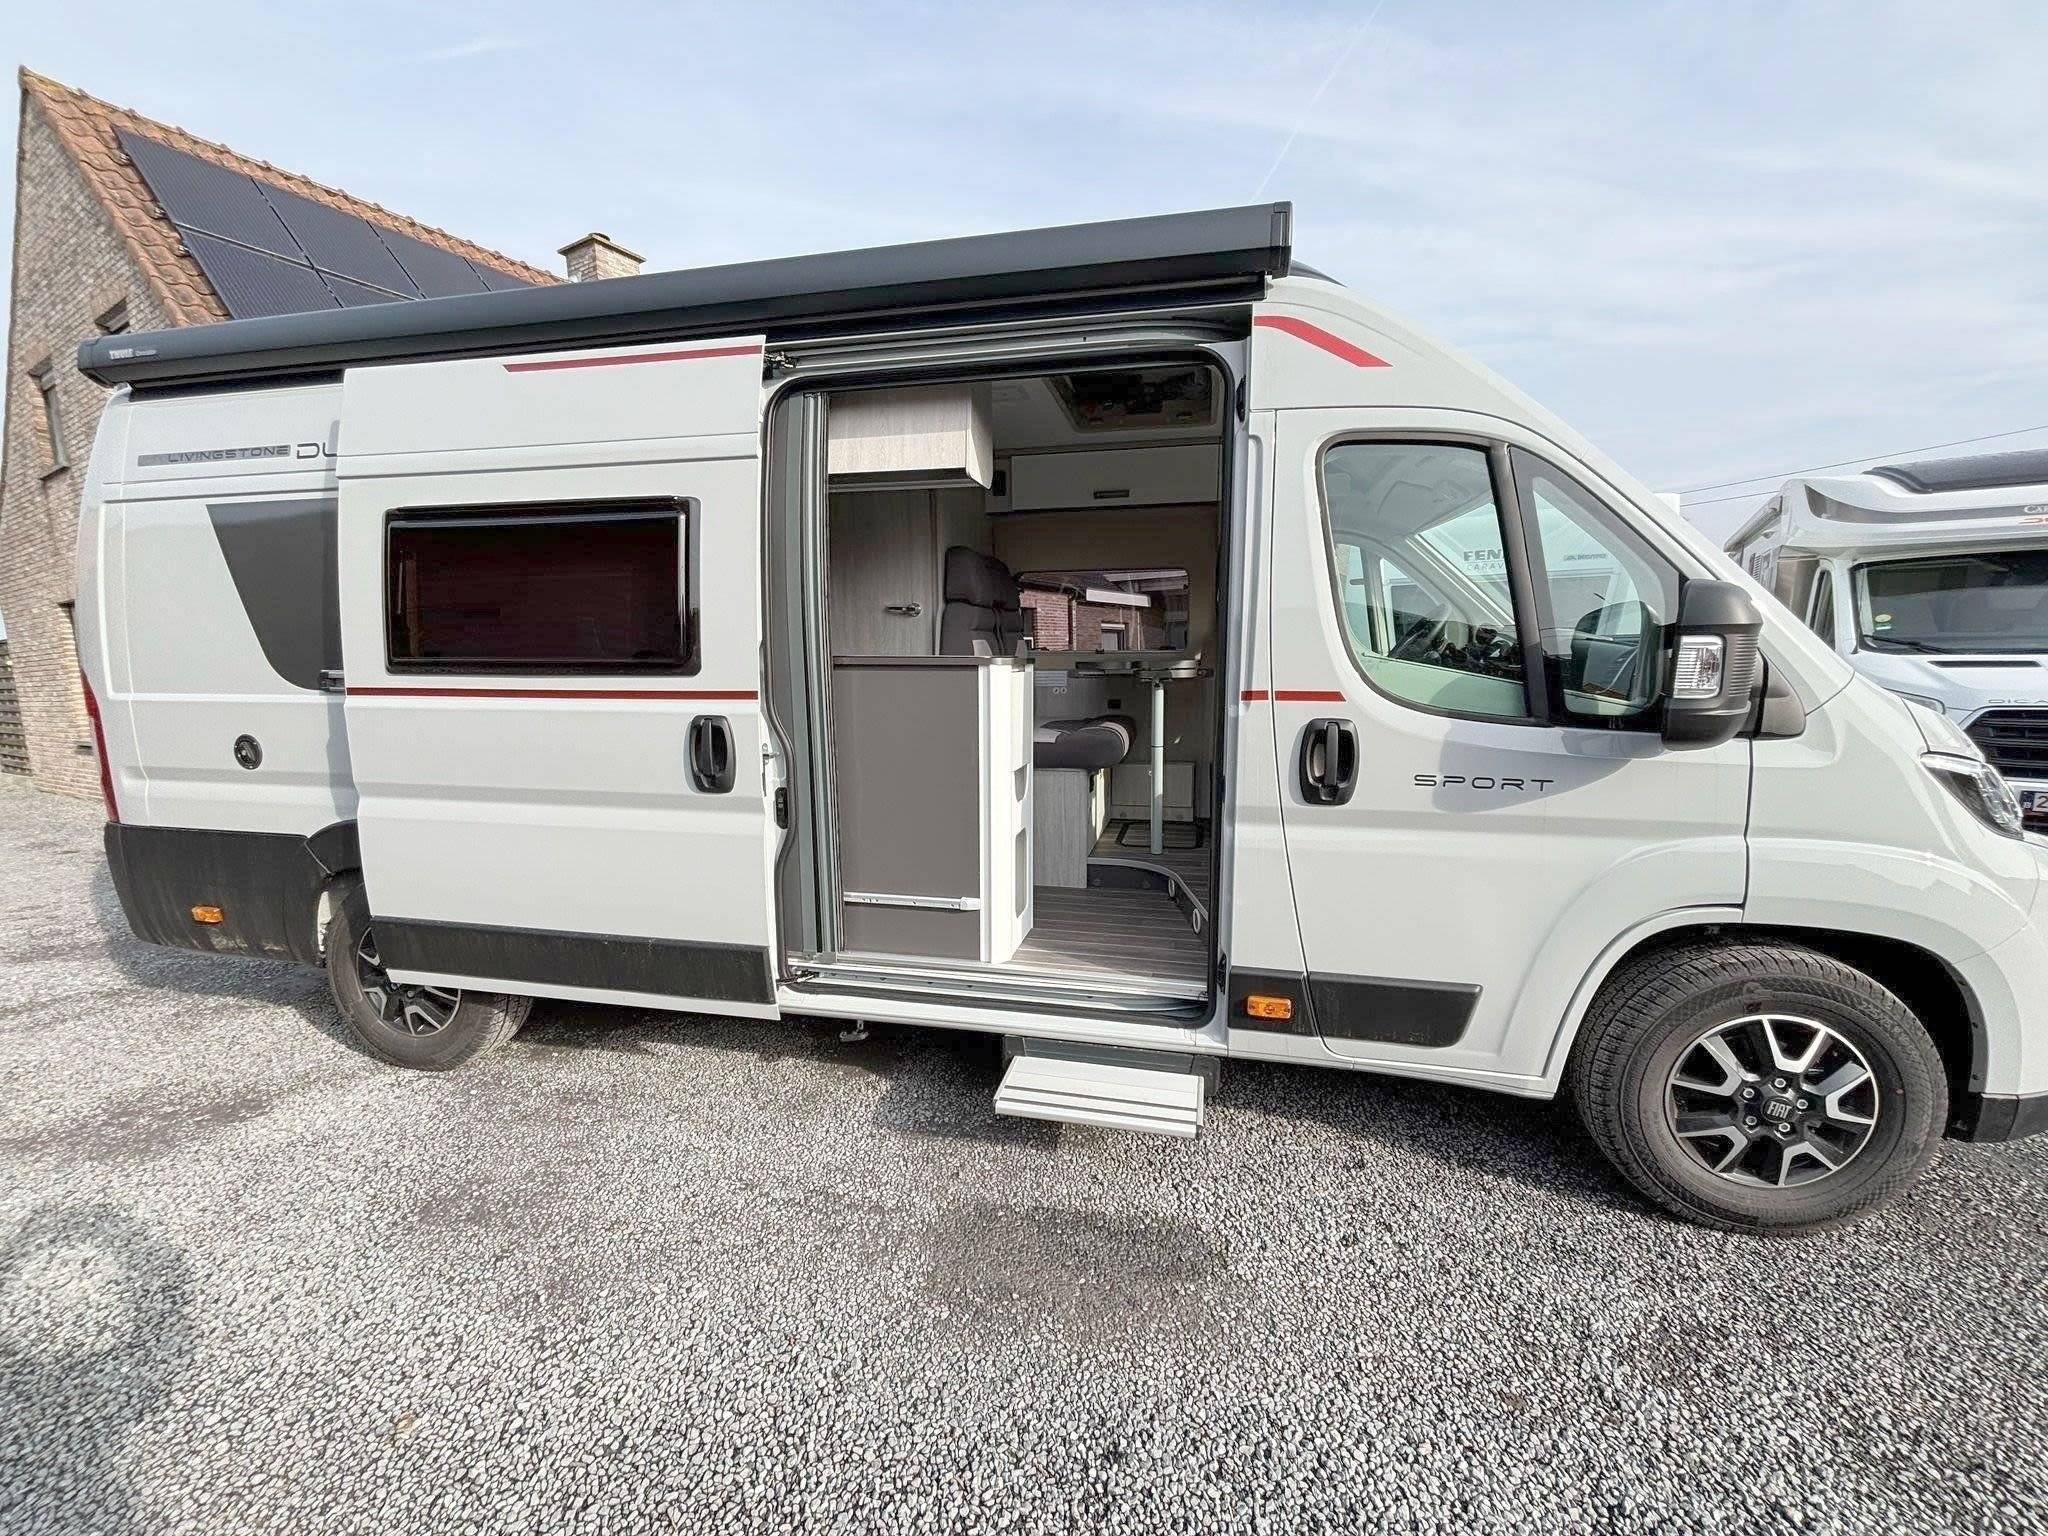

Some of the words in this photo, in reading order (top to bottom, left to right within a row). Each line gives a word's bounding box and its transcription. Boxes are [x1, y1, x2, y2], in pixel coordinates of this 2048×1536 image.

[168, 445, 290, 463] LIVINGSTONE
[1413, 774, 1555, 792] SPORT
[1766, 1100, 1794, 1120] FIAT
